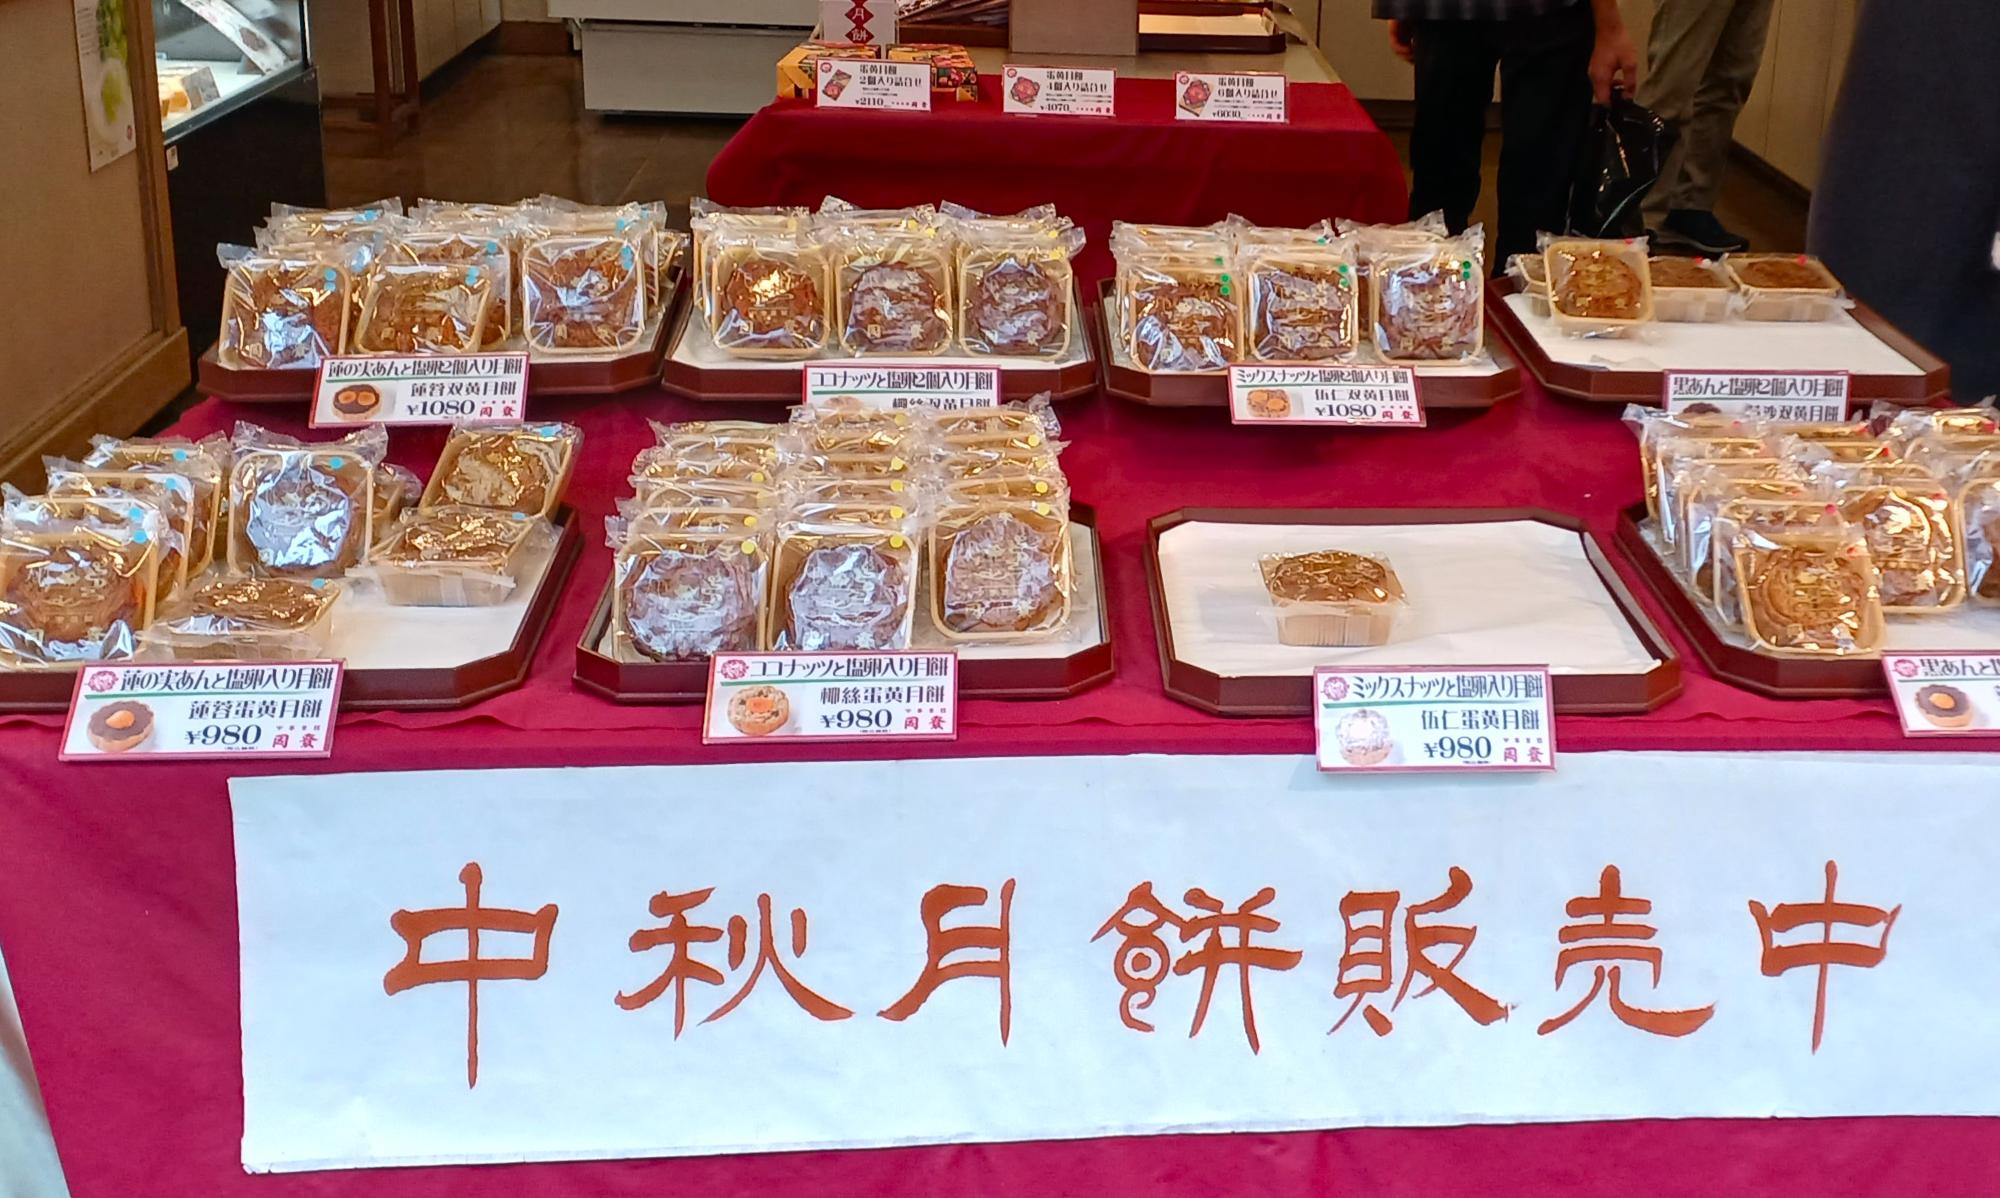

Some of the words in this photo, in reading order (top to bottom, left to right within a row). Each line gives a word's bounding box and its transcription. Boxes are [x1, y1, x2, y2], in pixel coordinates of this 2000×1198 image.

[810, 370, 994, 391] ココナッツと塩卵2個入り月餅
[406, 400, 475, 417] ¥1080
[1314, 403, 1377, 418] ¥1080
[749, 656, 949, 678] ココナッツと塩卵入り月餅
[119, 666, 334, 692] 蓮の実あんと塩卵入り月餅
[1351, 674, 1544, 699] ミックスナッツと塩卵入り月餅
[819, 708, 893, 729] ¥980
[184, 724, 262, 746] ¥980
[1423, 735, 1492, 760] ¥980
[384, 862, 1902, 1089] 中秋月餅販売中
